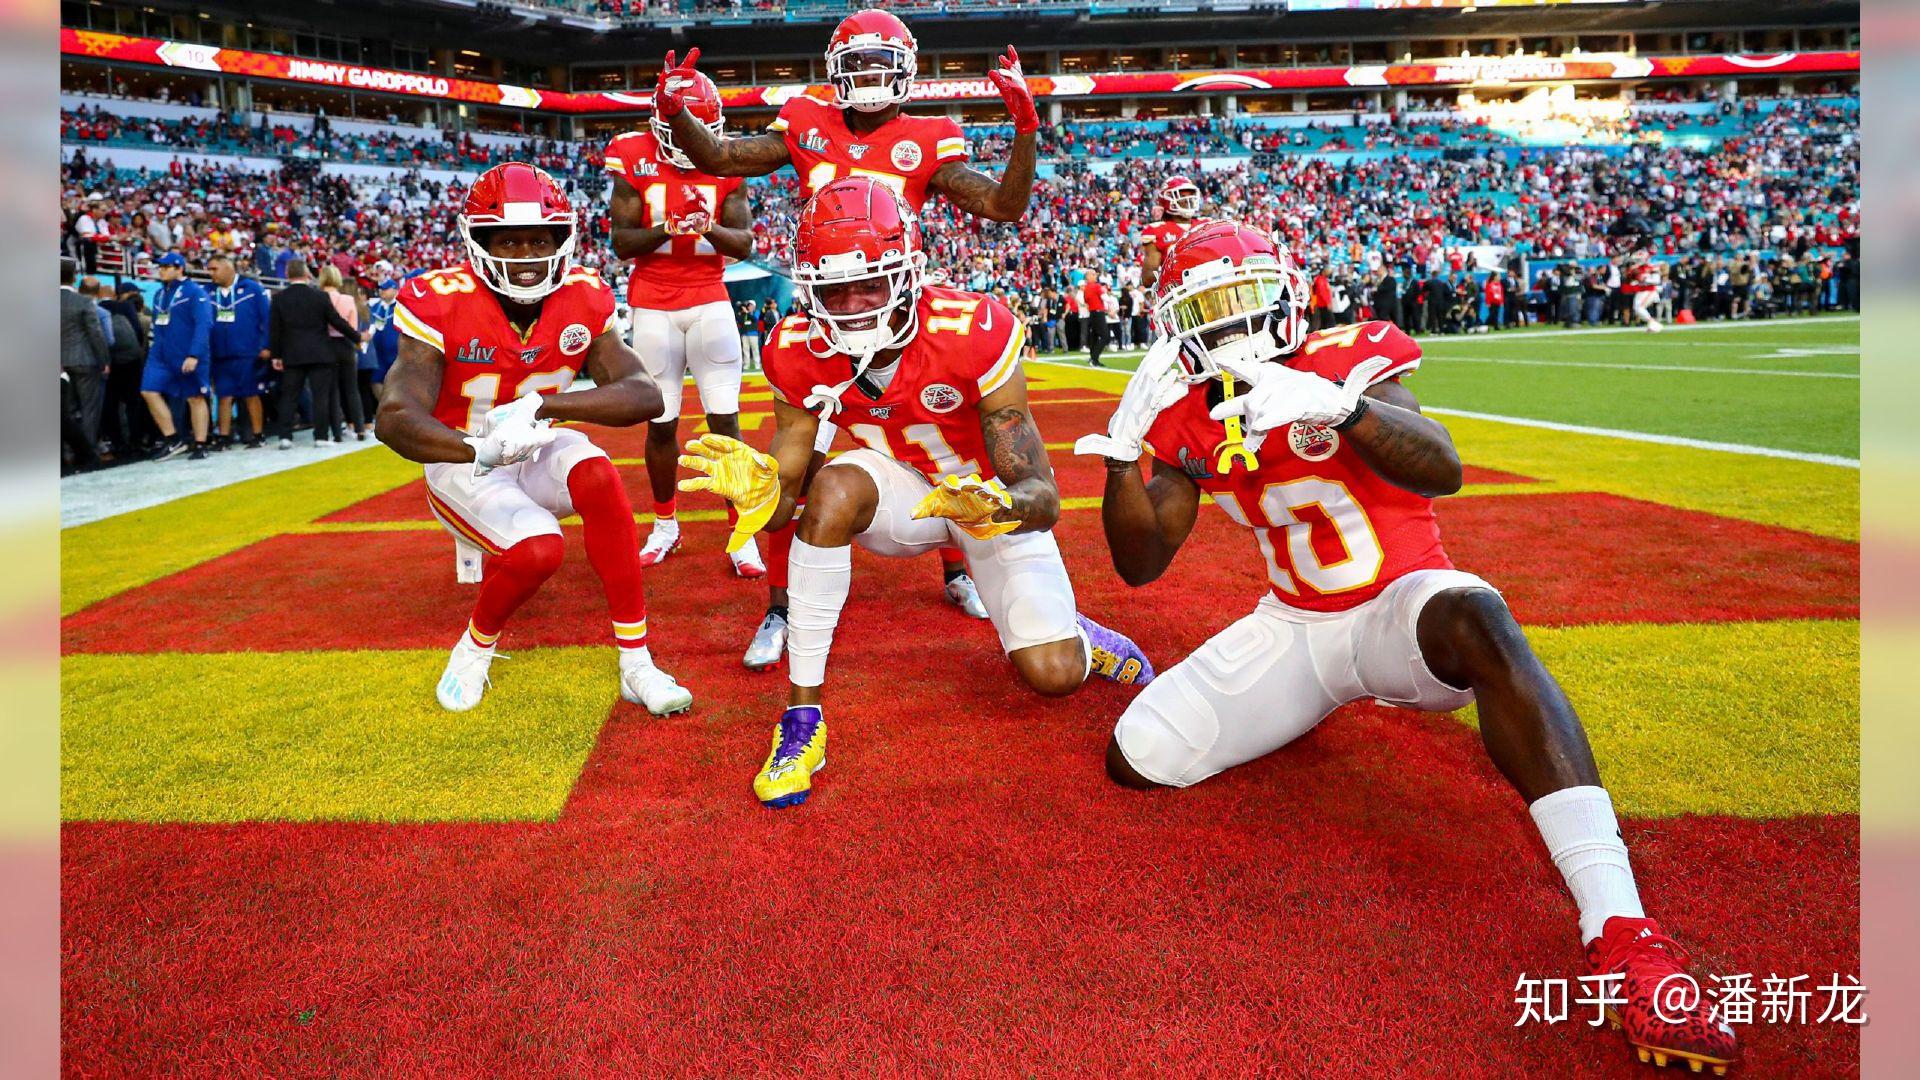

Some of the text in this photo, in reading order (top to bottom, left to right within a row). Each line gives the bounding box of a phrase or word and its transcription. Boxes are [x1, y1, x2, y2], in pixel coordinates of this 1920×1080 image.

[188, 50, 205, 64] 10
[287, 60, 449, 96] JIMMY GAROPPOLO
[926, 297, 984, 336] 11
[847, 423, 983, 487] 11
[1211, 475, 1386, 596] 10
